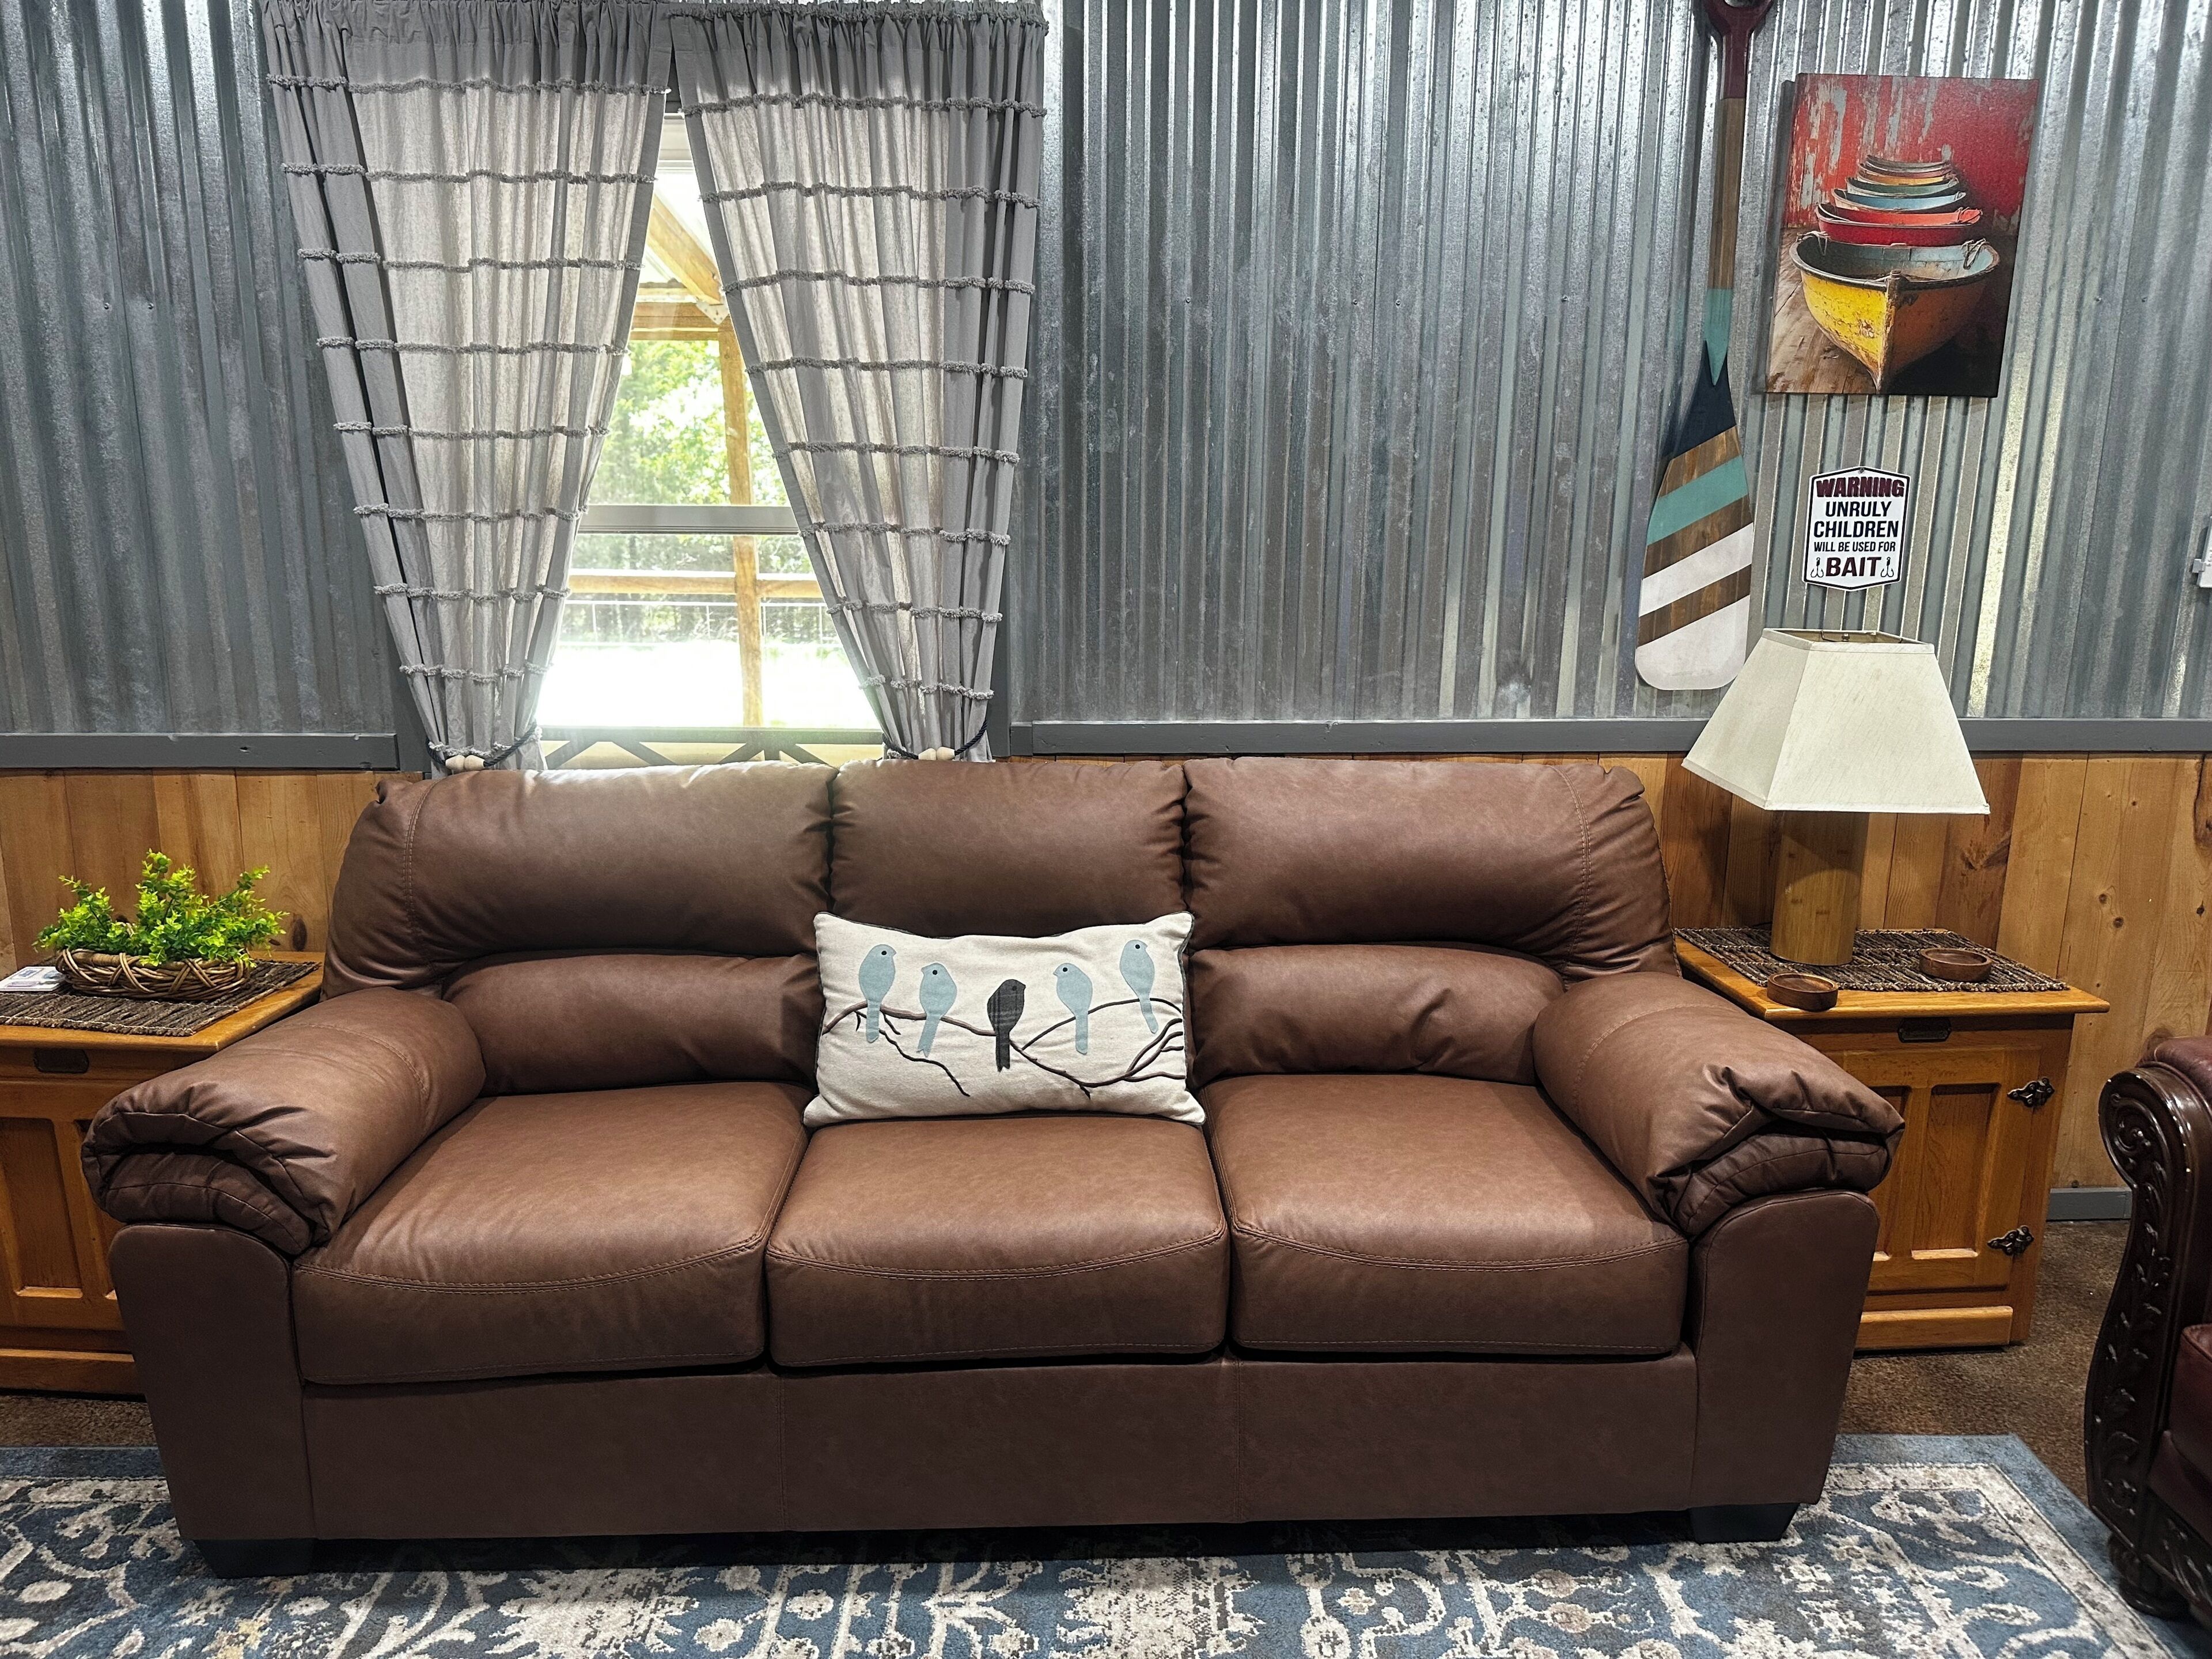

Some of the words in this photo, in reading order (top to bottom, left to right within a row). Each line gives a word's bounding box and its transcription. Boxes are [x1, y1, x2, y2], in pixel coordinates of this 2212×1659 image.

[1816, 476, 1904, 497] WARNING
[1825, 501, 1892, 517] UNRULY
[1814, 520, 1899, 537] CHILDREN
[1814, 541, 1835, 552] WILL
[1838, 541, 1850, 552] BE
[1853, 541, 1876, 552] USED
[1878, 541, 1896, 552] FOR
[1825, 556, 1882, 577] BAIT
